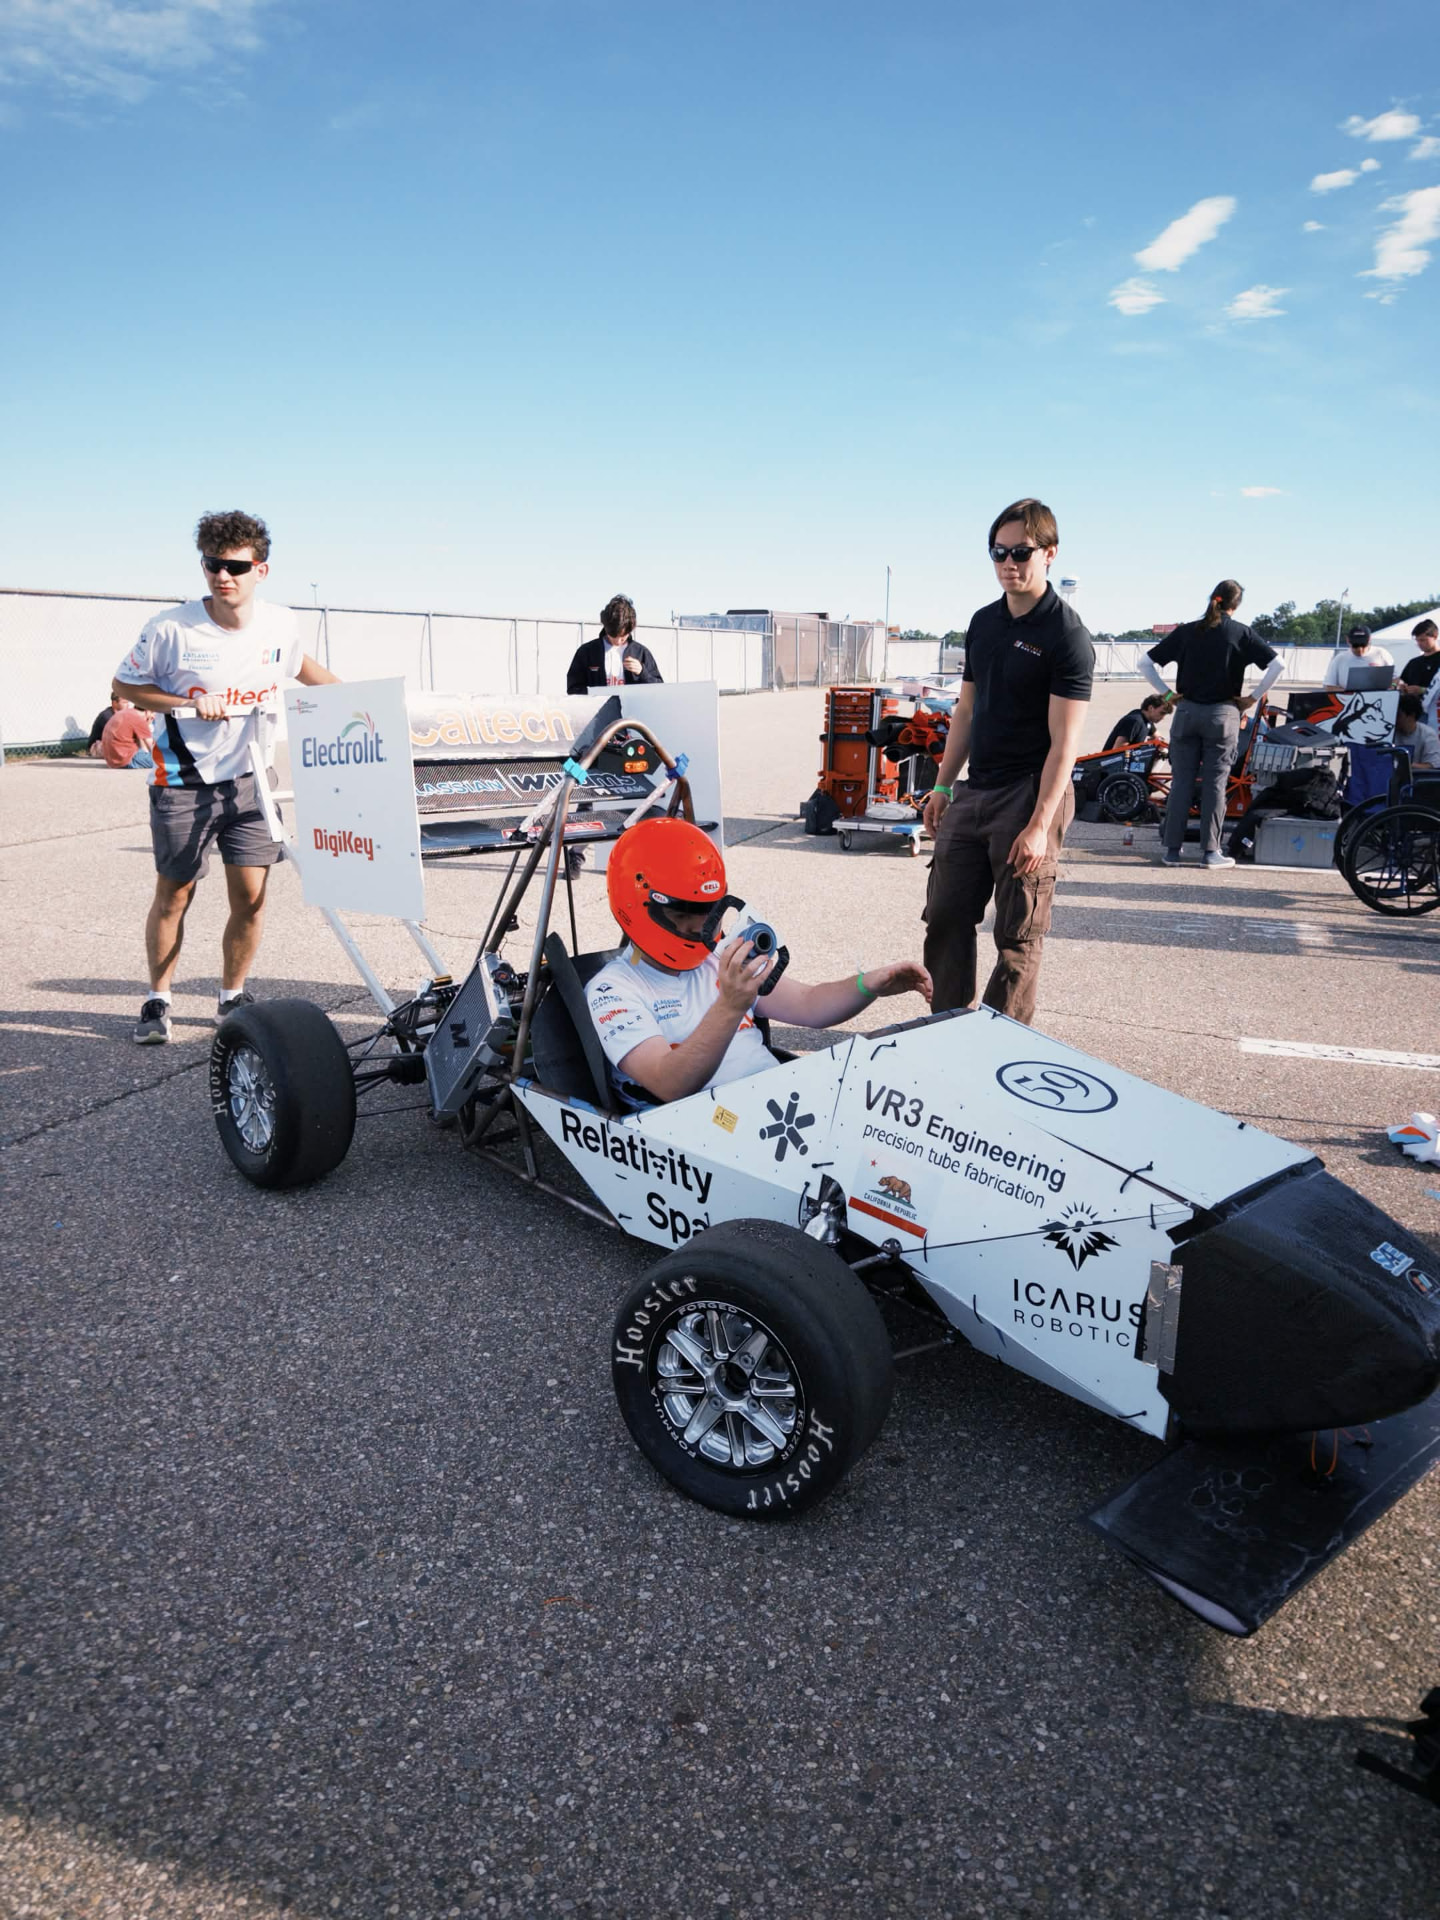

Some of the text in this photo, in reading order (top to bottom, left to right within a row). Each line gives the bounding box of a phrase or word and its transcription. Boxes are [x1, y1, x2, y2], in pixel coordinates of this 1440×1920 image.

[187, 682, 279, 706] Cltec
[301, 731, 385, 768] Electrolit
[416, 778, 507, 797] ASSIAN
[313, 828, 374, 861] DigiKey
[703, 883, 719, 891] BELL
[1014, 1070, 1091, 1106] 59
[560, 1107, 713, 1205] Relativity
[865, 1080, 1067, 1193] VR3 Engineering
[862, 1122, 1046, 1209] precision tube fabrication
[864, 1192, 918, 1221] CALIFORNIA REPUBLIC
[615, 1275, 698, 1373] Hoosier
[677, 1301, 739, 1316] FORGED
[1013, 1277, 1147, 1328] ICARUS
[650, 1386, 698, 1459] FORMULA
[777, 1408, 806, 1462] KEIZER
[746, 1408, 835, 1510] Hoosier
